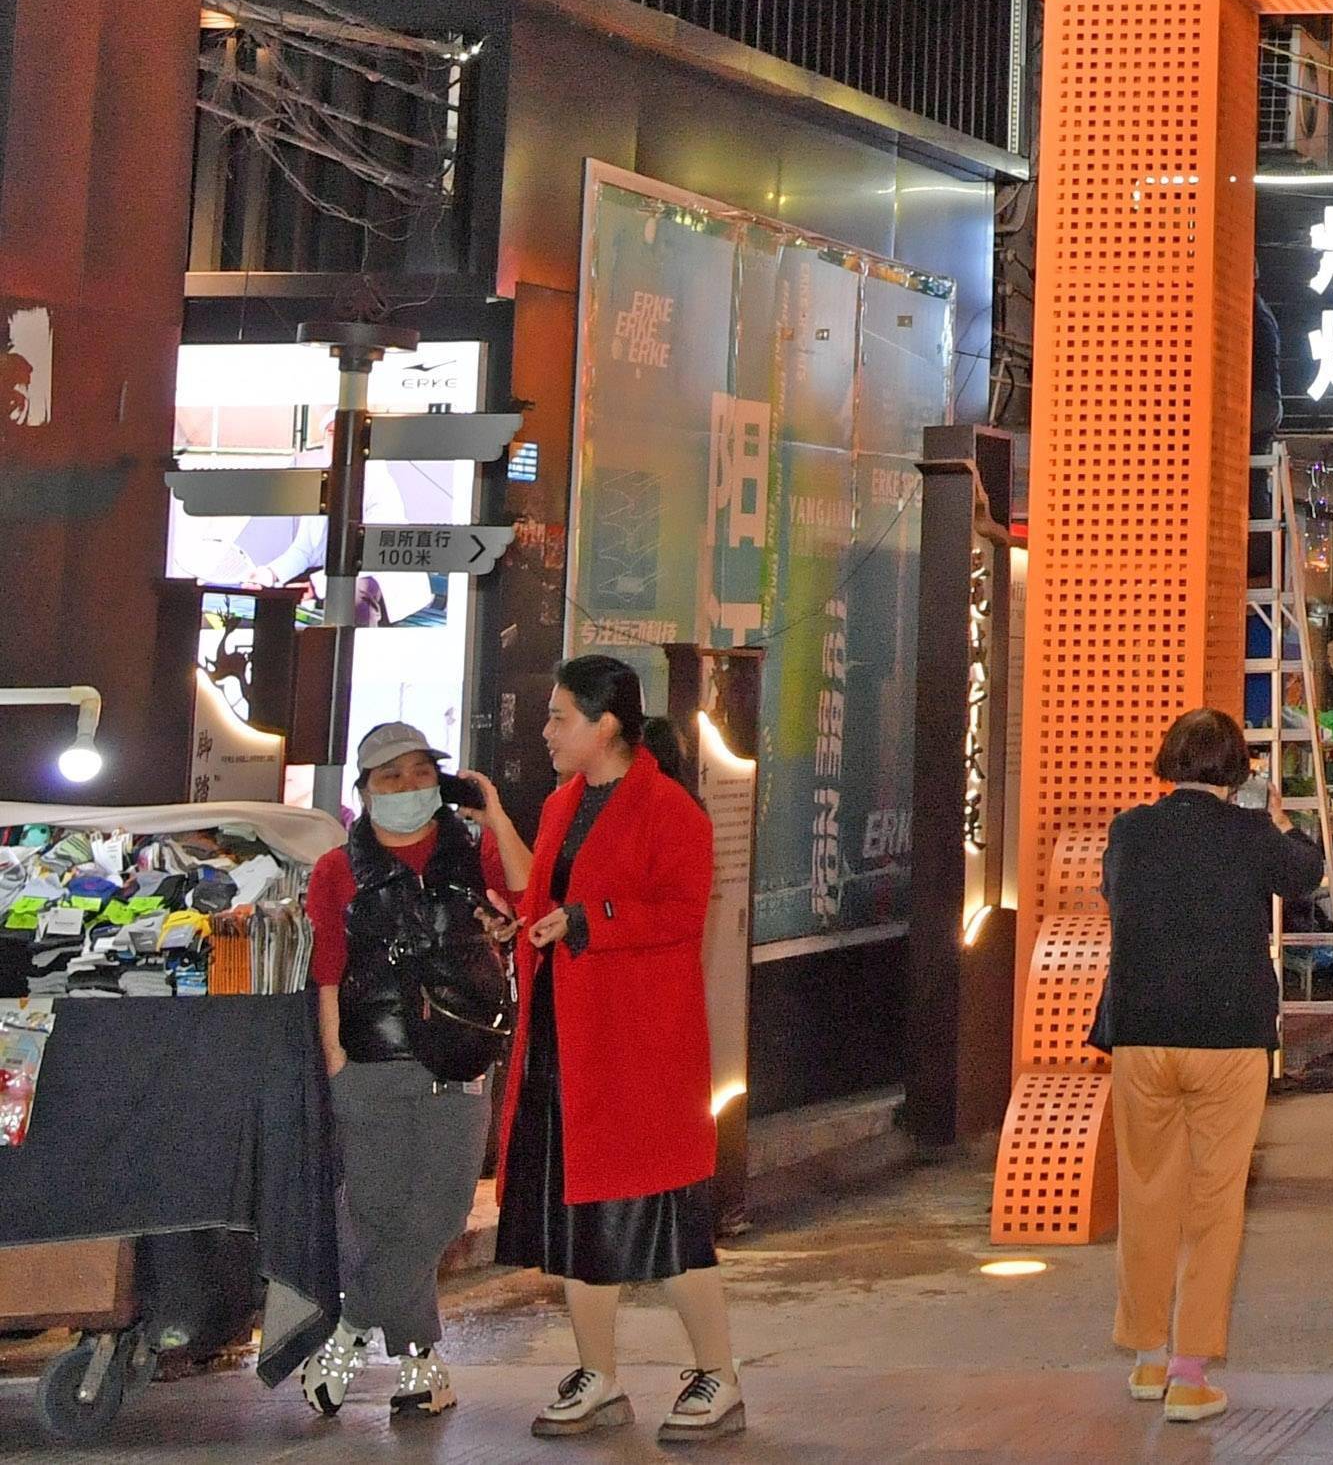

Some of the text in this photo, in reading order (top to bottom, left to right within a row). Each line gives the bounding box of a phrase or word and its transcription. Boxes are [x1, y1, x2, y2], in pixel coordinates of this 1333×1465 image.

[401, 377, 458, 389] ERKE
[379, 530, 452, 548] 厕所直行
[378, 549, 432, 566] 100米
